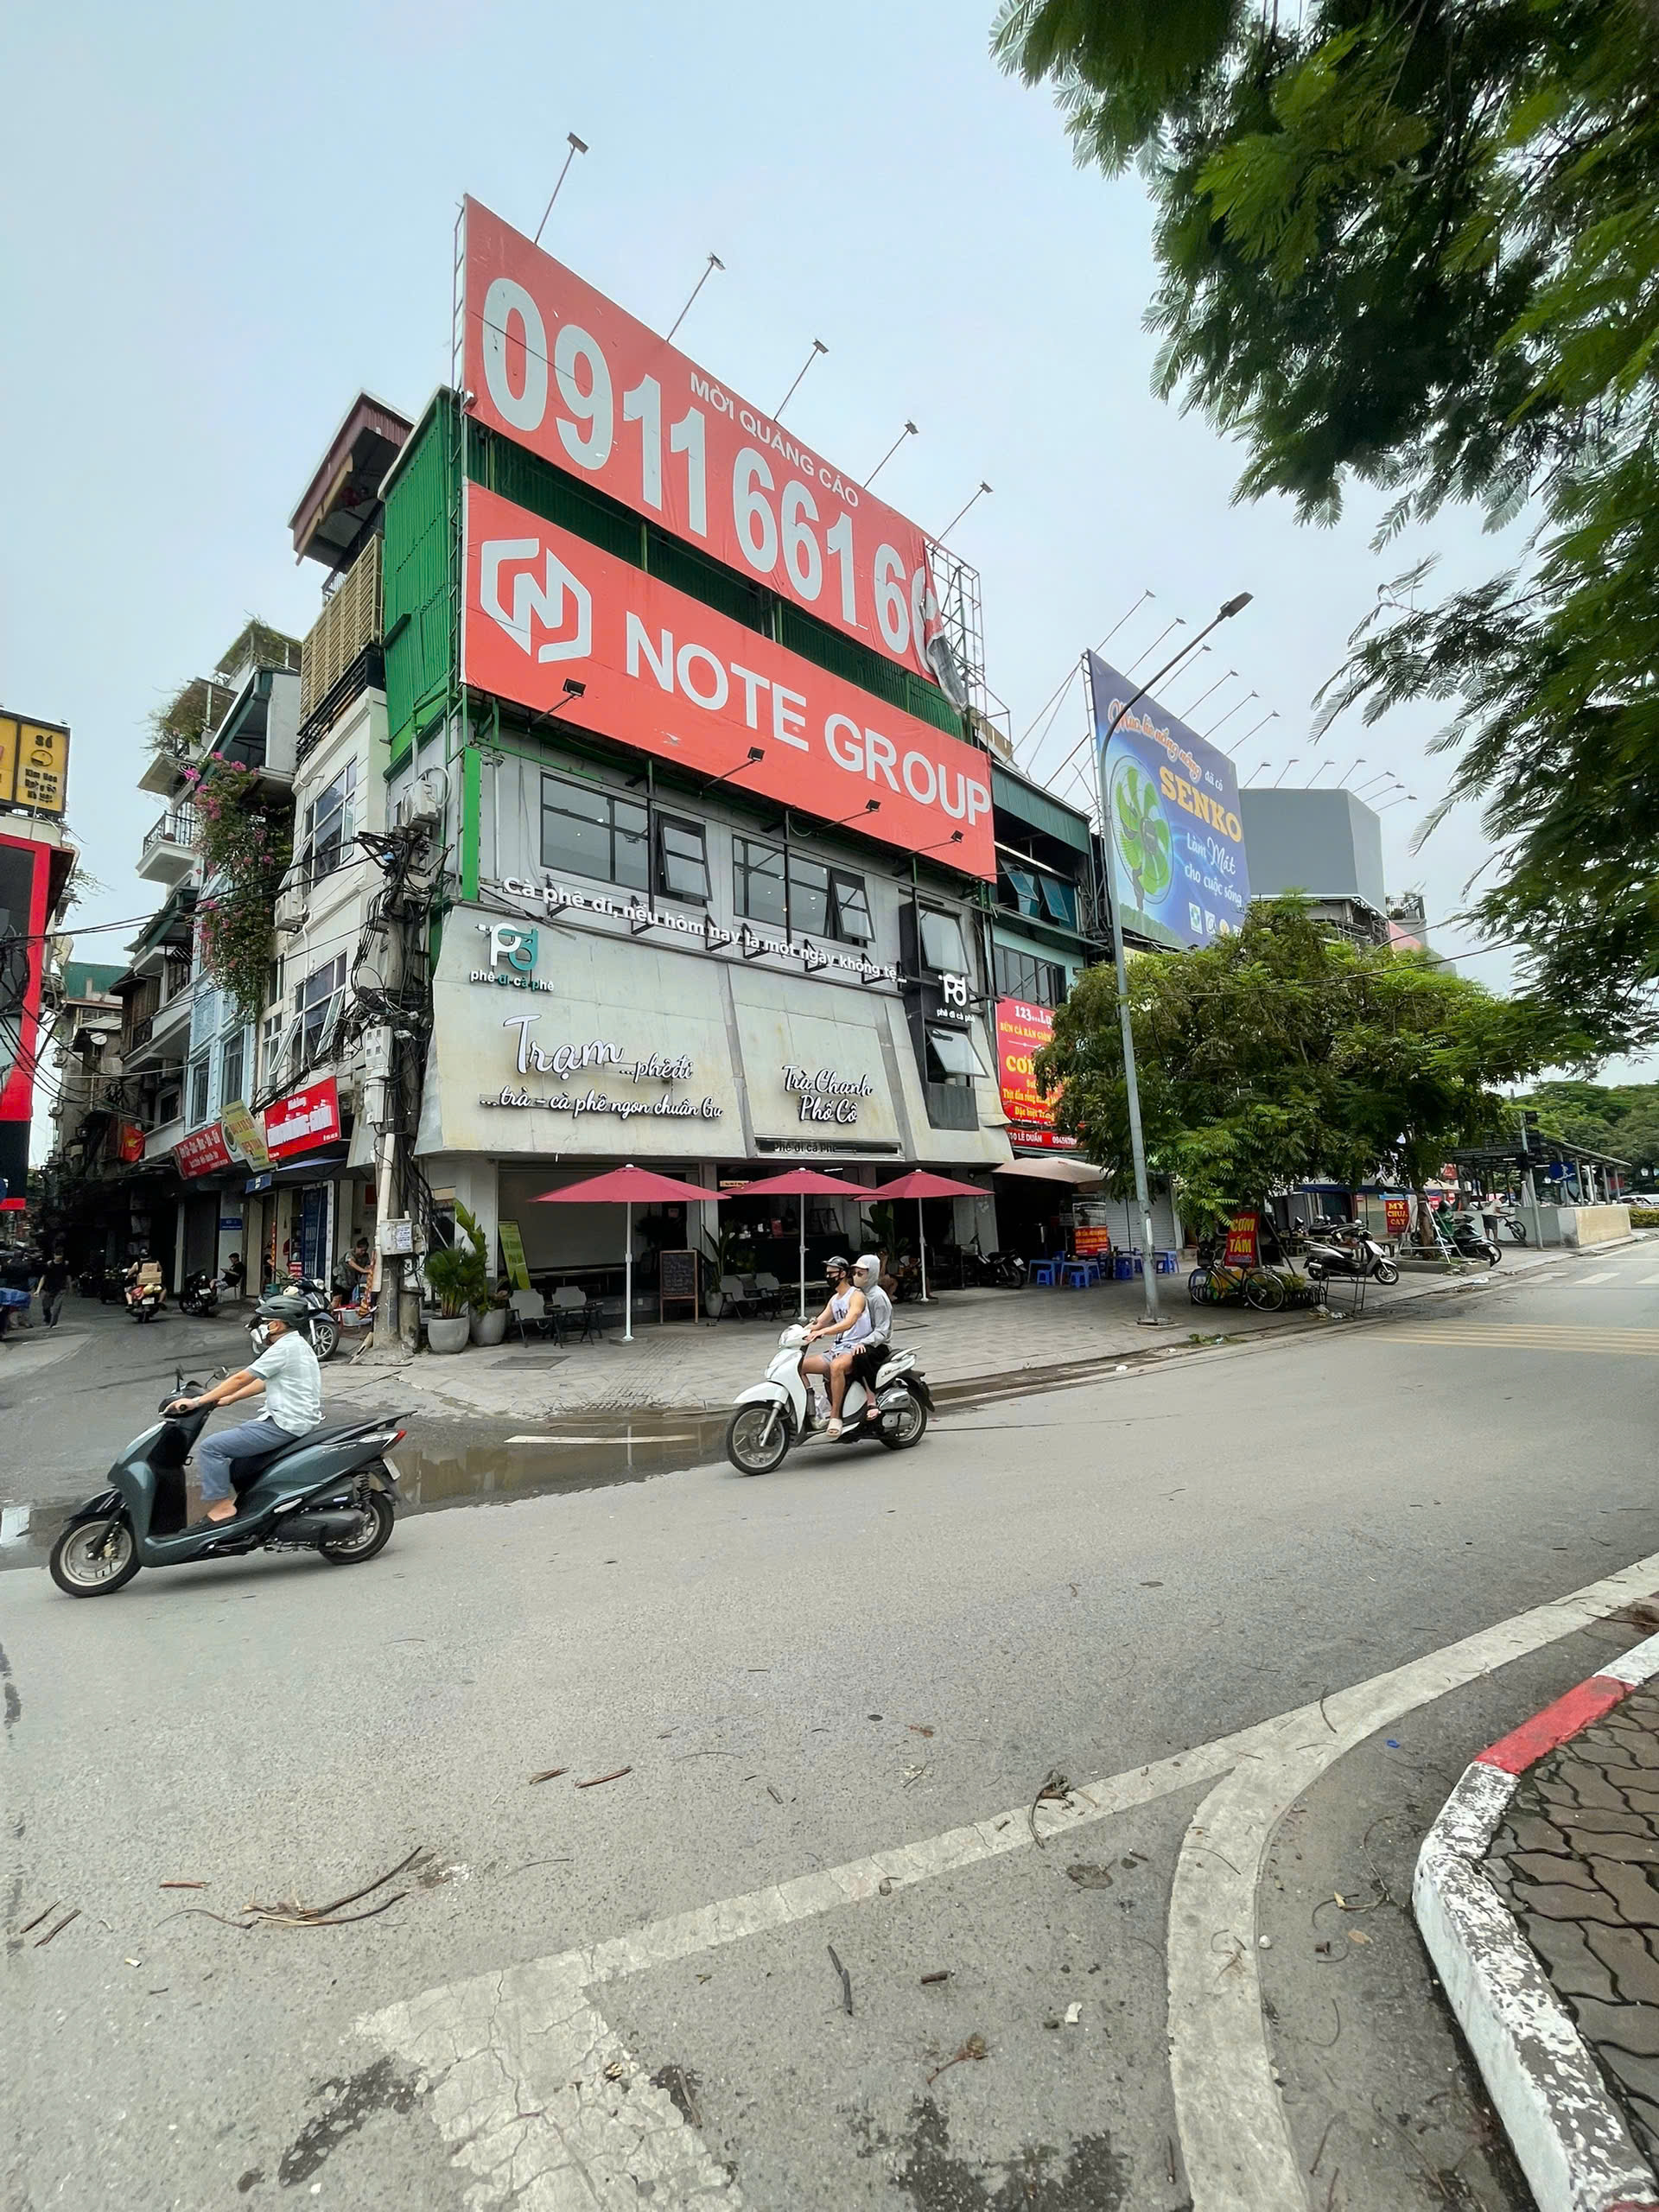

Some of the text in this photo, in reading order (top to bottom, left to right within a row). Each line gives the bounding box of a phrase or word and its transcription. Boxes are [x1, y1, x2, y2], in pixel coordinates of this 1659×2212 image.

[482, 277, 707, 538] 0911
[733, 448, 857, 626] 661
[691, 372, 734, 421] MỜI
[819, 468, 859, 507] CÁO
[626, 610, 990, 826] NOTE GROUP
[1160, 766, 1242, 842] SENKO
[1187, 832, 1236, 874] Làm Mát
[1185, 863, 1243, 908] cho cuộc sống
[503, 876, 536, 899] Cà
[543, 887, 585, 907] phê
[623, 901, 659, 925] nếu
[664, 912, 707, 936] hôm
[709, 925, 740, 945] nay
[745, 931, 760, 949] là
[765, 939, 796, 959] một
[801, 949, 836, 969] ngày
[839, 955, 880, 978] không
[471, 969, 495, 982] phê
[531, 979, 554, 992] phê
[503, 1014, 623, 1080] Trạm
[550, 1092, 570, 1110] cà
[572, 1089, 607, 1118] phê
[611, 1100, 650, 1120] ngon
[653, 1094, 698, 1116] chuẩn
[701, 1096, 723, 1118] Gu
[782, 1065, 873, 1096] Trà Chanh
[799, 1095, 835, 1122] Phố
